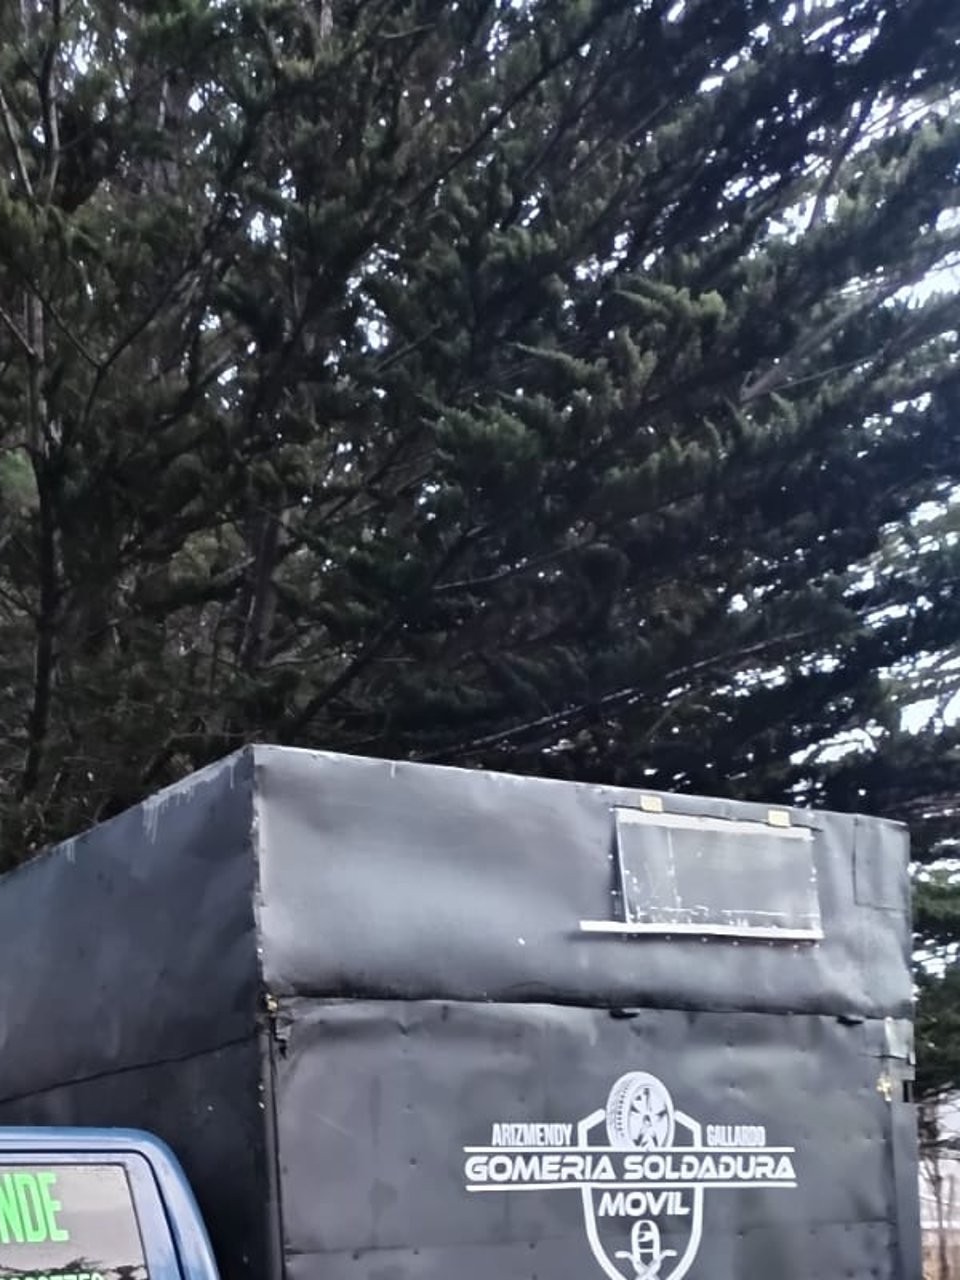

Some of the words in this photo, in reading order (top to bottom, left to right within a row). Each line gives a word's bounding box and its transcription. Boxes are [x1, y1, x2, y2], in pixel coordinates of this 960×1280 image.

[491, 1123, 574, 1147] ARIZMENDY
[464, 1155, 616, 1182] GOMERIA
[623, 1154, 797, 1181] SOLDADURA
[598, 1191, 691, 1217] MOVIL
